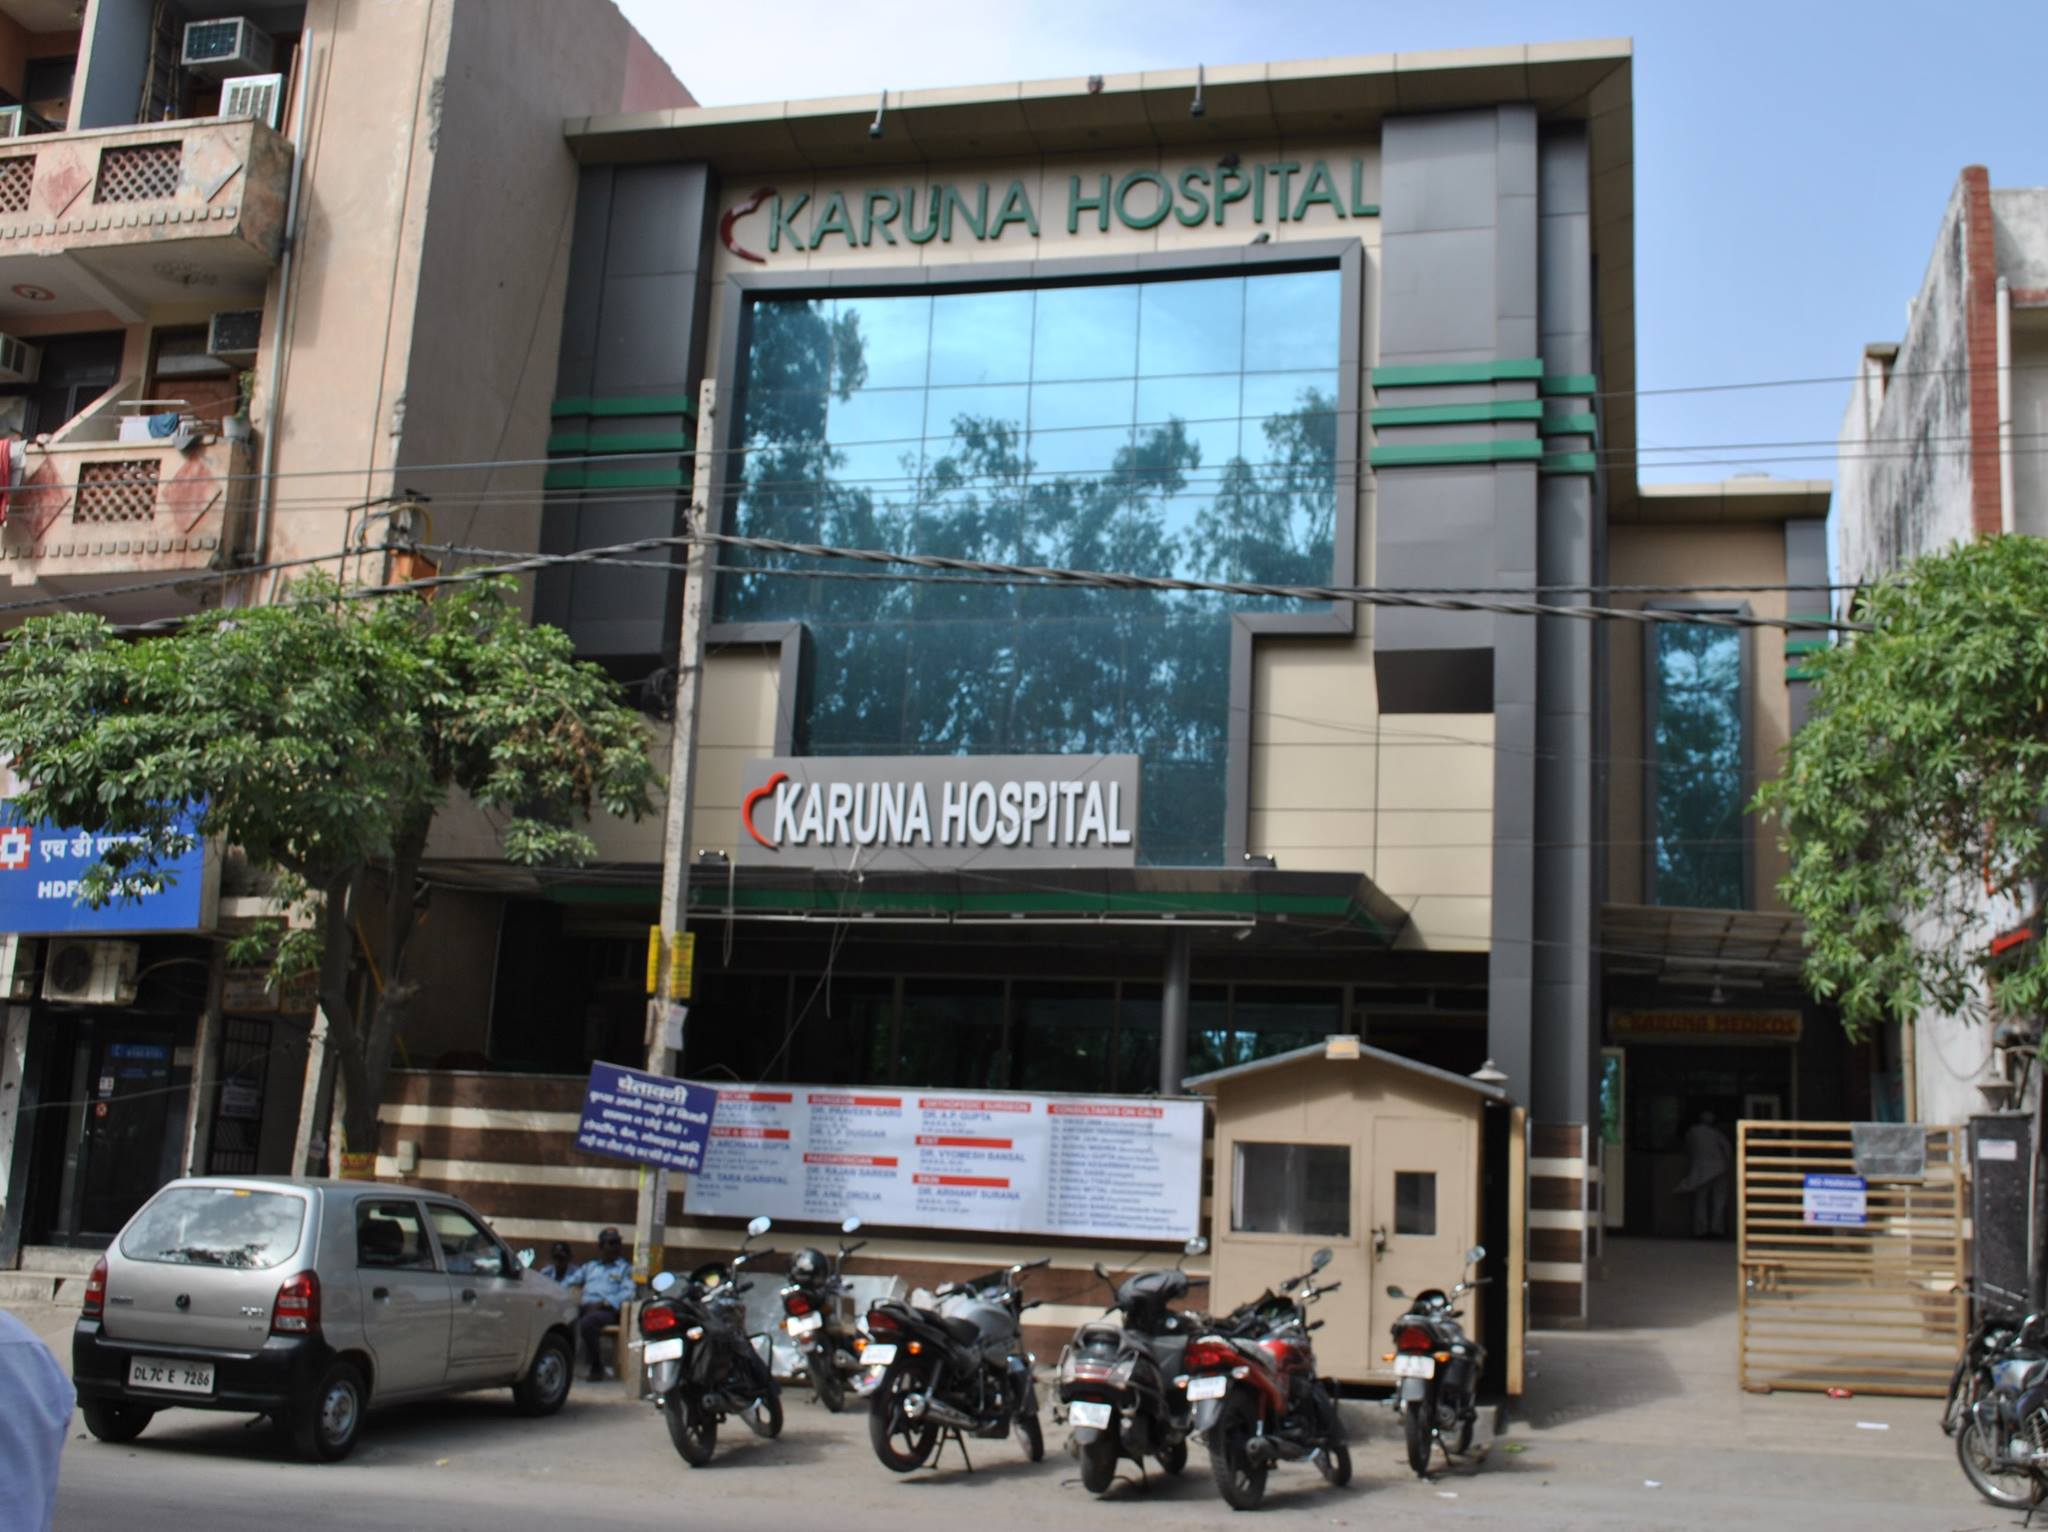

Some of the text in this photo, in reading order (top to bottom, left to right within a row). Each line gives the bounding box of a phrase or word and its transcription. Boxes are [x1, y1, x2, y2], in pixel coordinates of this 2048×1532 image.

[768, 156, 1381, 252] KARUNA HOSPITAL
[40, 838, 68, 863] एच
[71, 831, 94, 858] डी
[773, 781, 1132, 847] KARUNA HOSPITAL
